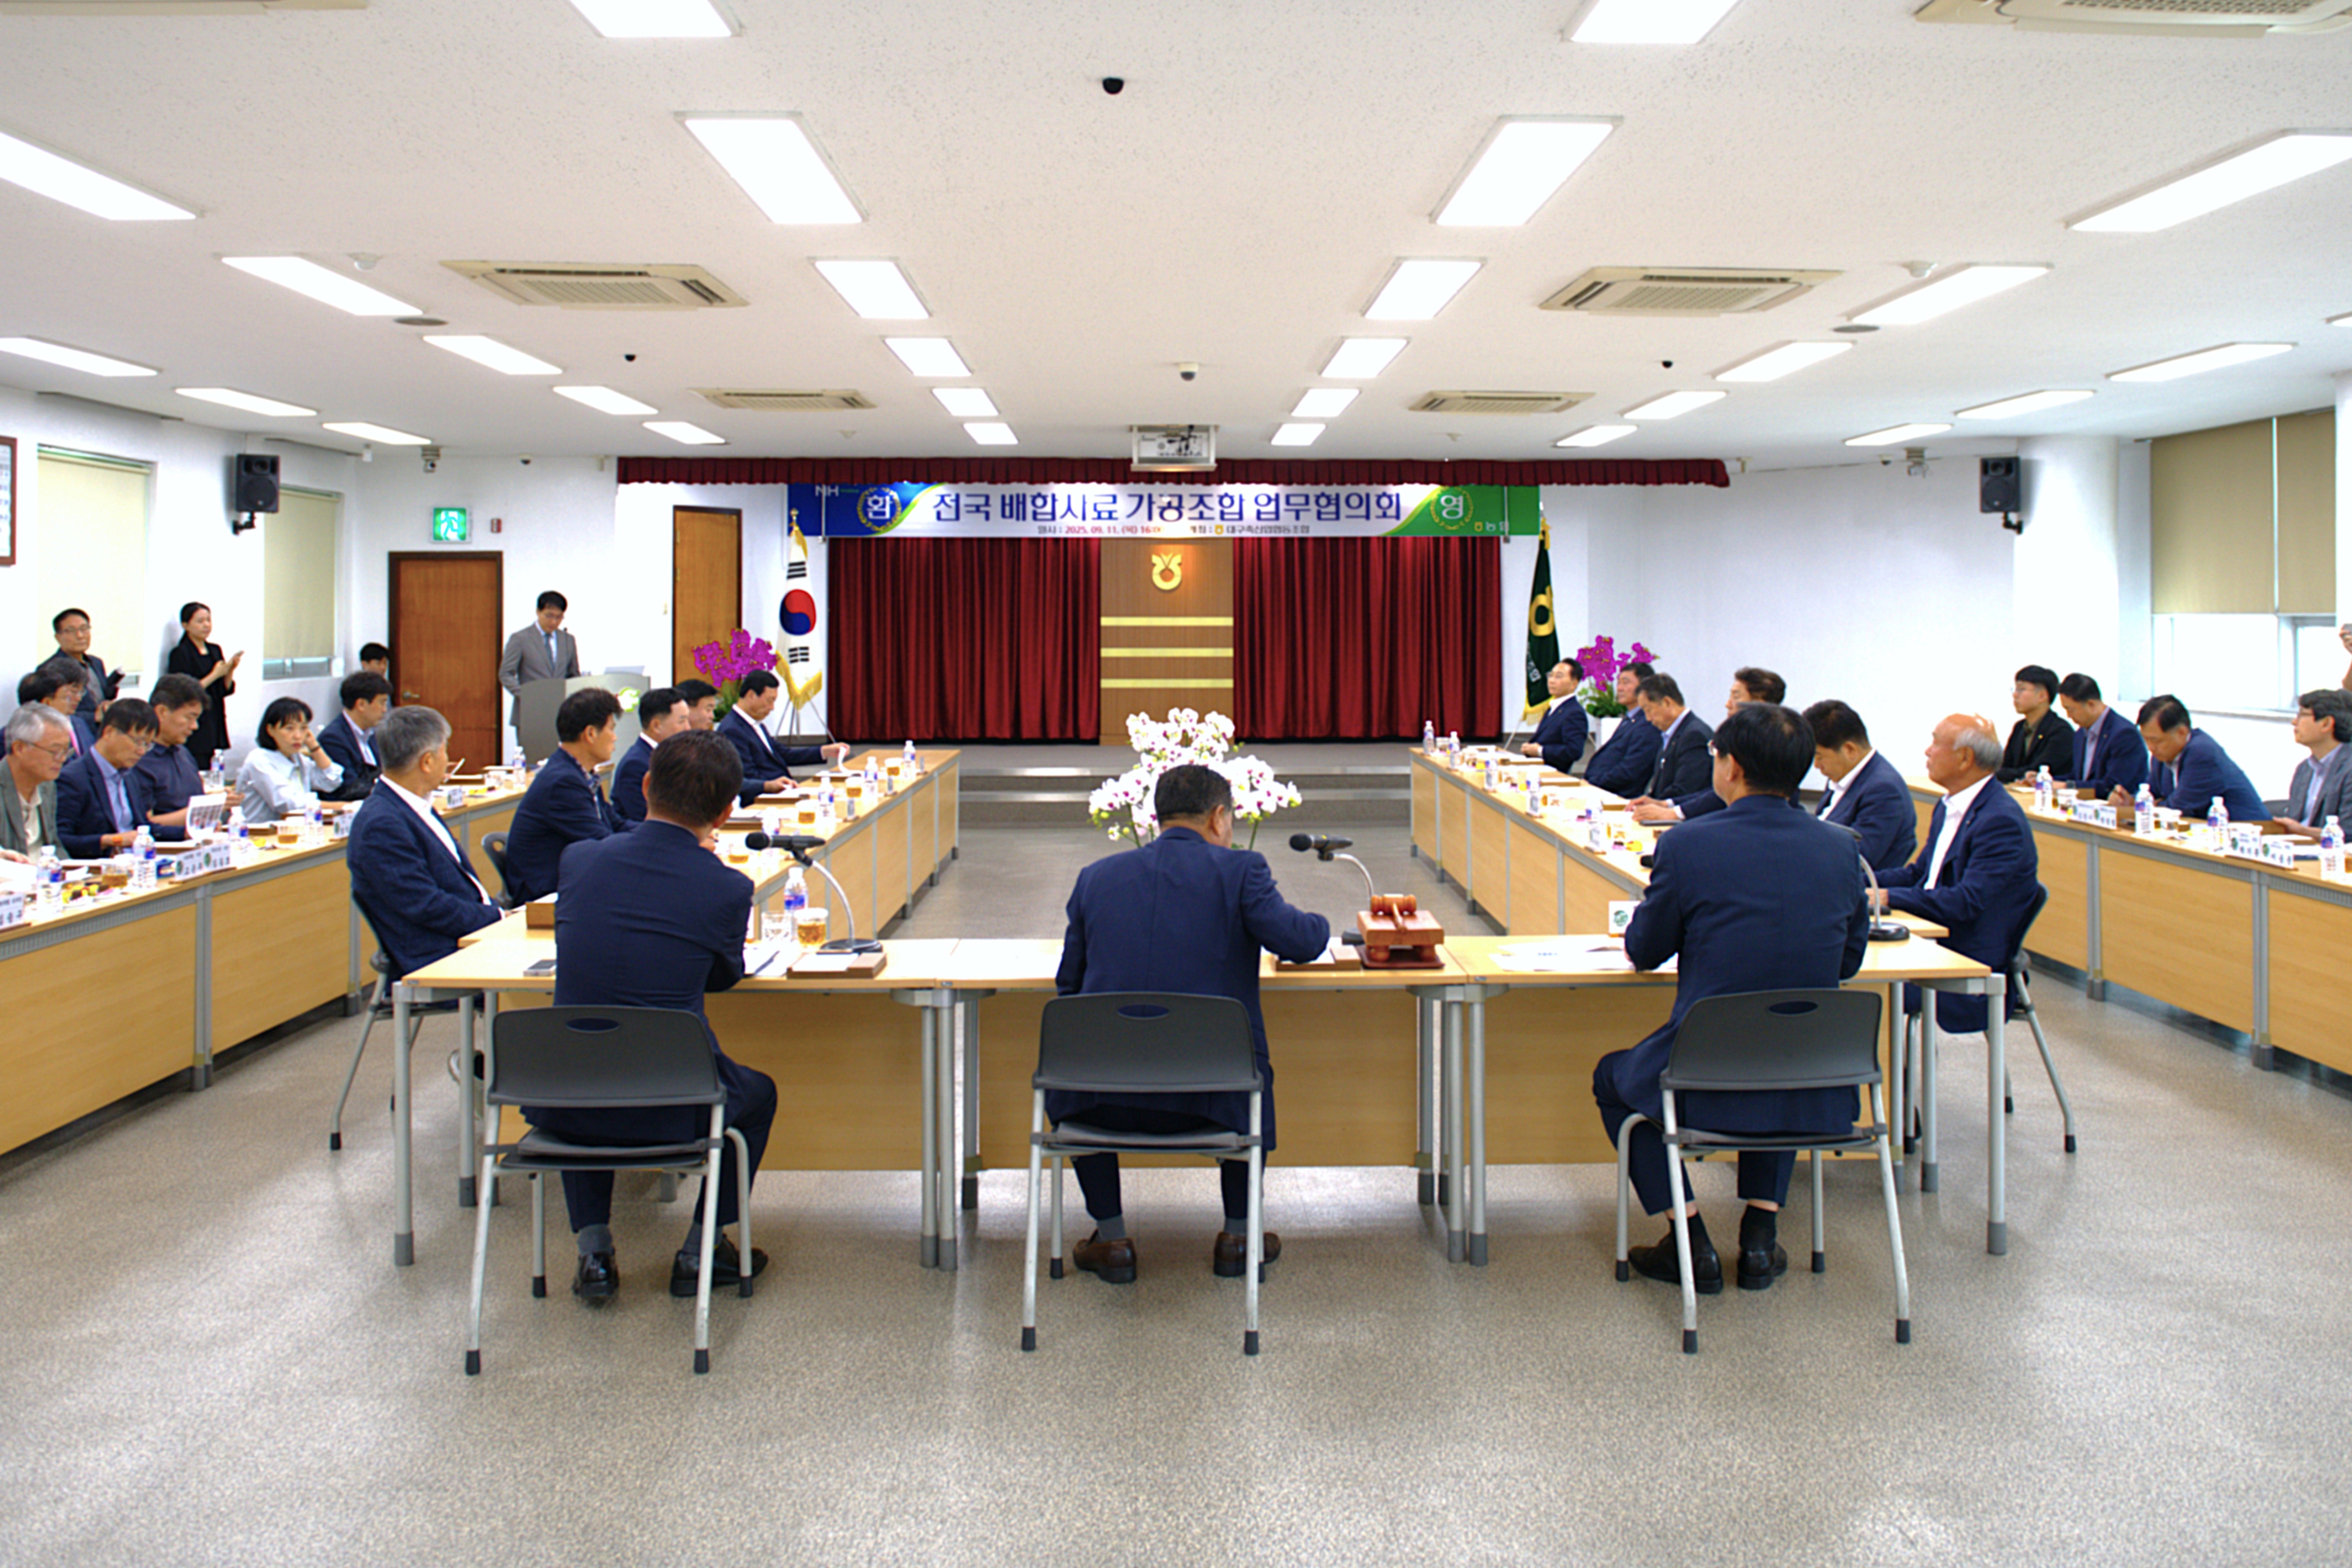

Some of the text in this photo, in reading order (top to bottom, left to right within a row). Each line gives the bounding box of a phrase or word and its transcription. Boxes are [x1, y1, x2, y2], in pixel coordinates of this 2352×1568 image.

[815, 485, 839, 496] NH
[867, 495, 892, 519] 환
[933, 492, 1400, 522] 전국 배합사료 가공조합 업무협의회
[1441, 495, 1463, 519] 영
[1038, 525, 1056, 534] 일시
[1065, 525, 1088, 534] 2025.
[1107, 525, 1119, 534] 11.
